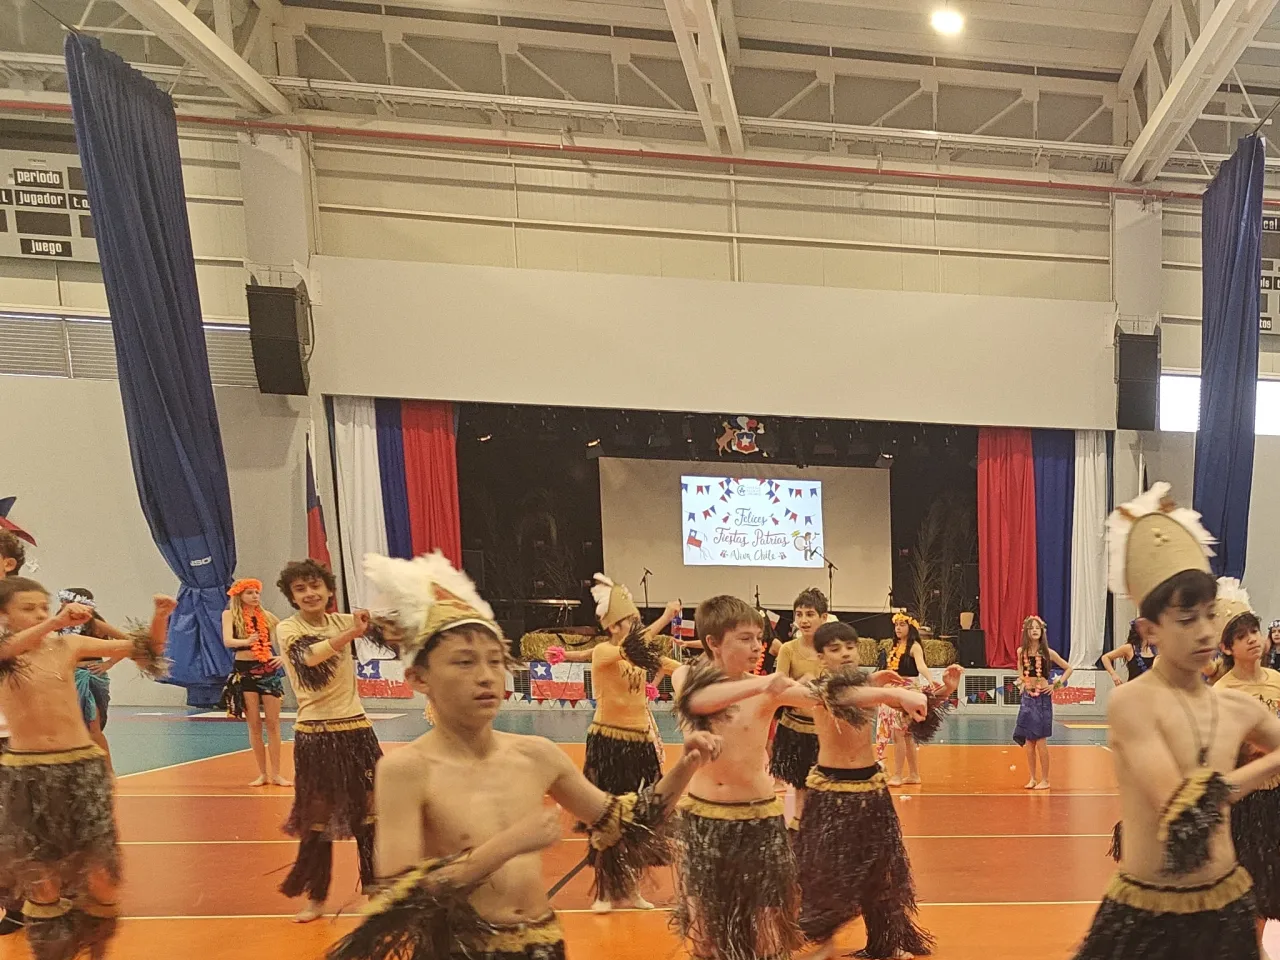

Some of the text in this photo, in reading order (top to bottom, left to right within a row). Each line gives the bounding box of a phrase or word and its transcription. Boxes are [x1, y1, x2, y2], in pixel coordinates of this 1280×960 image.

[17, 170, 60, 184] periodo
[19, 191, 63, 205] jugador
[31, 240, 62, 255] juego
[734, 508, 768, 527] Felices
[713, 527, 790, 547] Fiestas Patrias
[731, 548, 777, 562] Viva Chile
